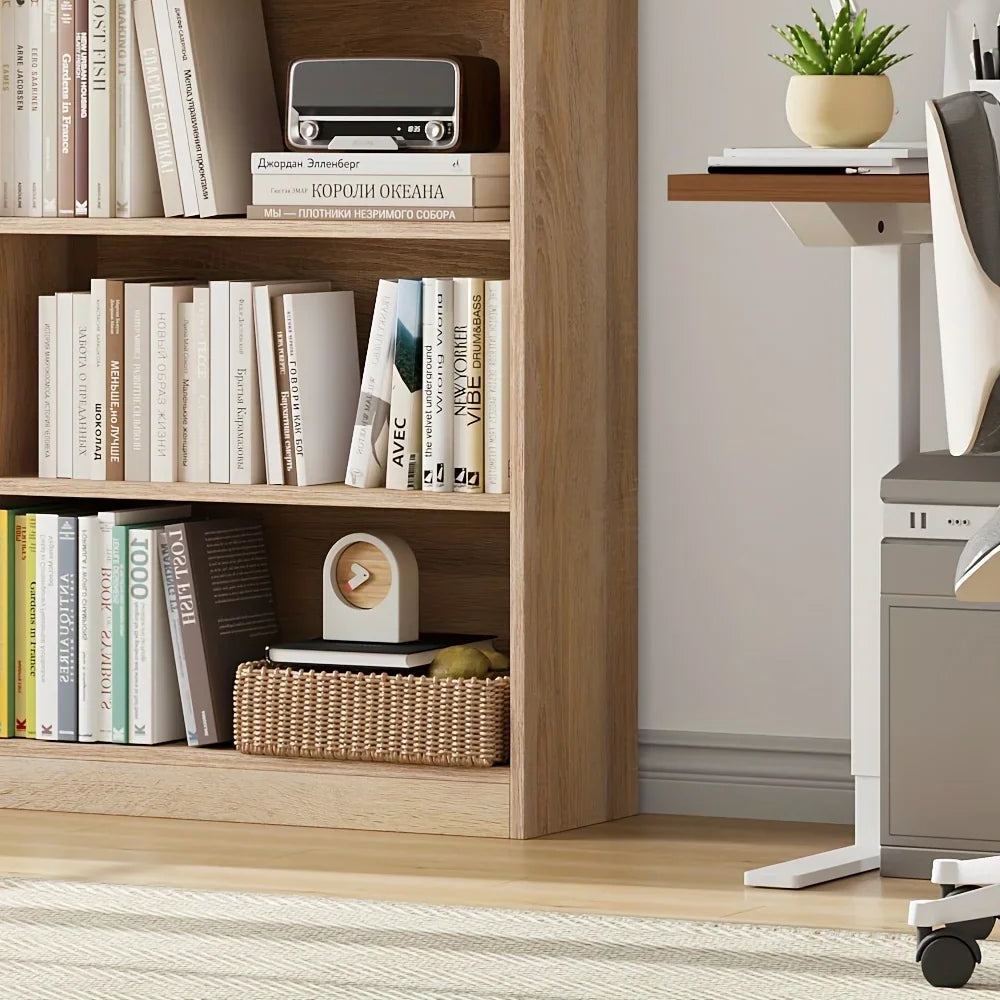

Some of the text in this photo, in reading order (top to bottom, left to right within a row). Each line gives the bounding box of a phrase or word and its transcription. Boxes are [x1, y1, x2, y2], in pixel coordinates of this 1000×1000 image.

[117, 3, 127, 59] MAKING
[2, 64, 10, 91] EAMES
[16, 44, 24, 111] ARNE JACOBSEN
[92, 49, 106, 91] FISH
[117, 62, 126, 76] IT
[143, 48, 163, 109] СПАСИТЕ
[62, 54, 71, 154] Gardens in France
[184, 70, 209, 200] Метод управления проектами
[258, 158, 360, 170] Джордан Элленберг
[264, 209, 456, 220] МЫ ПЛОТНИКИ НЕЗРИМОГО СОБОРА
[312, 184, 445, 199] КОРОЛИ ОКЕАНА
[157, 312, 167, 457] НОВЫЙ ОБРАЗ ЖИЗНИ
[290, 362, 299, 410] ГОВОРИ
[425, 345, 433, 408] underground
[436, 354, 444, 414] Wrong
[454, 325, 467, 416] NEW YORKER
[467, 295, 481, 426] VIBE DRUM&BASS
[78, 326, 87, 456] ЗАБОТА О ПРЕДАННЫХ
[235, 368, 247, 470] Братья Карамазовы
[281, 391, 290, 438] Бархатная
[94, 403, 102, 461] ШОКОЛАД
[111, 425, 120, 462] ЛУЧШЕ
[393, 417, 406, 467] AVEC
